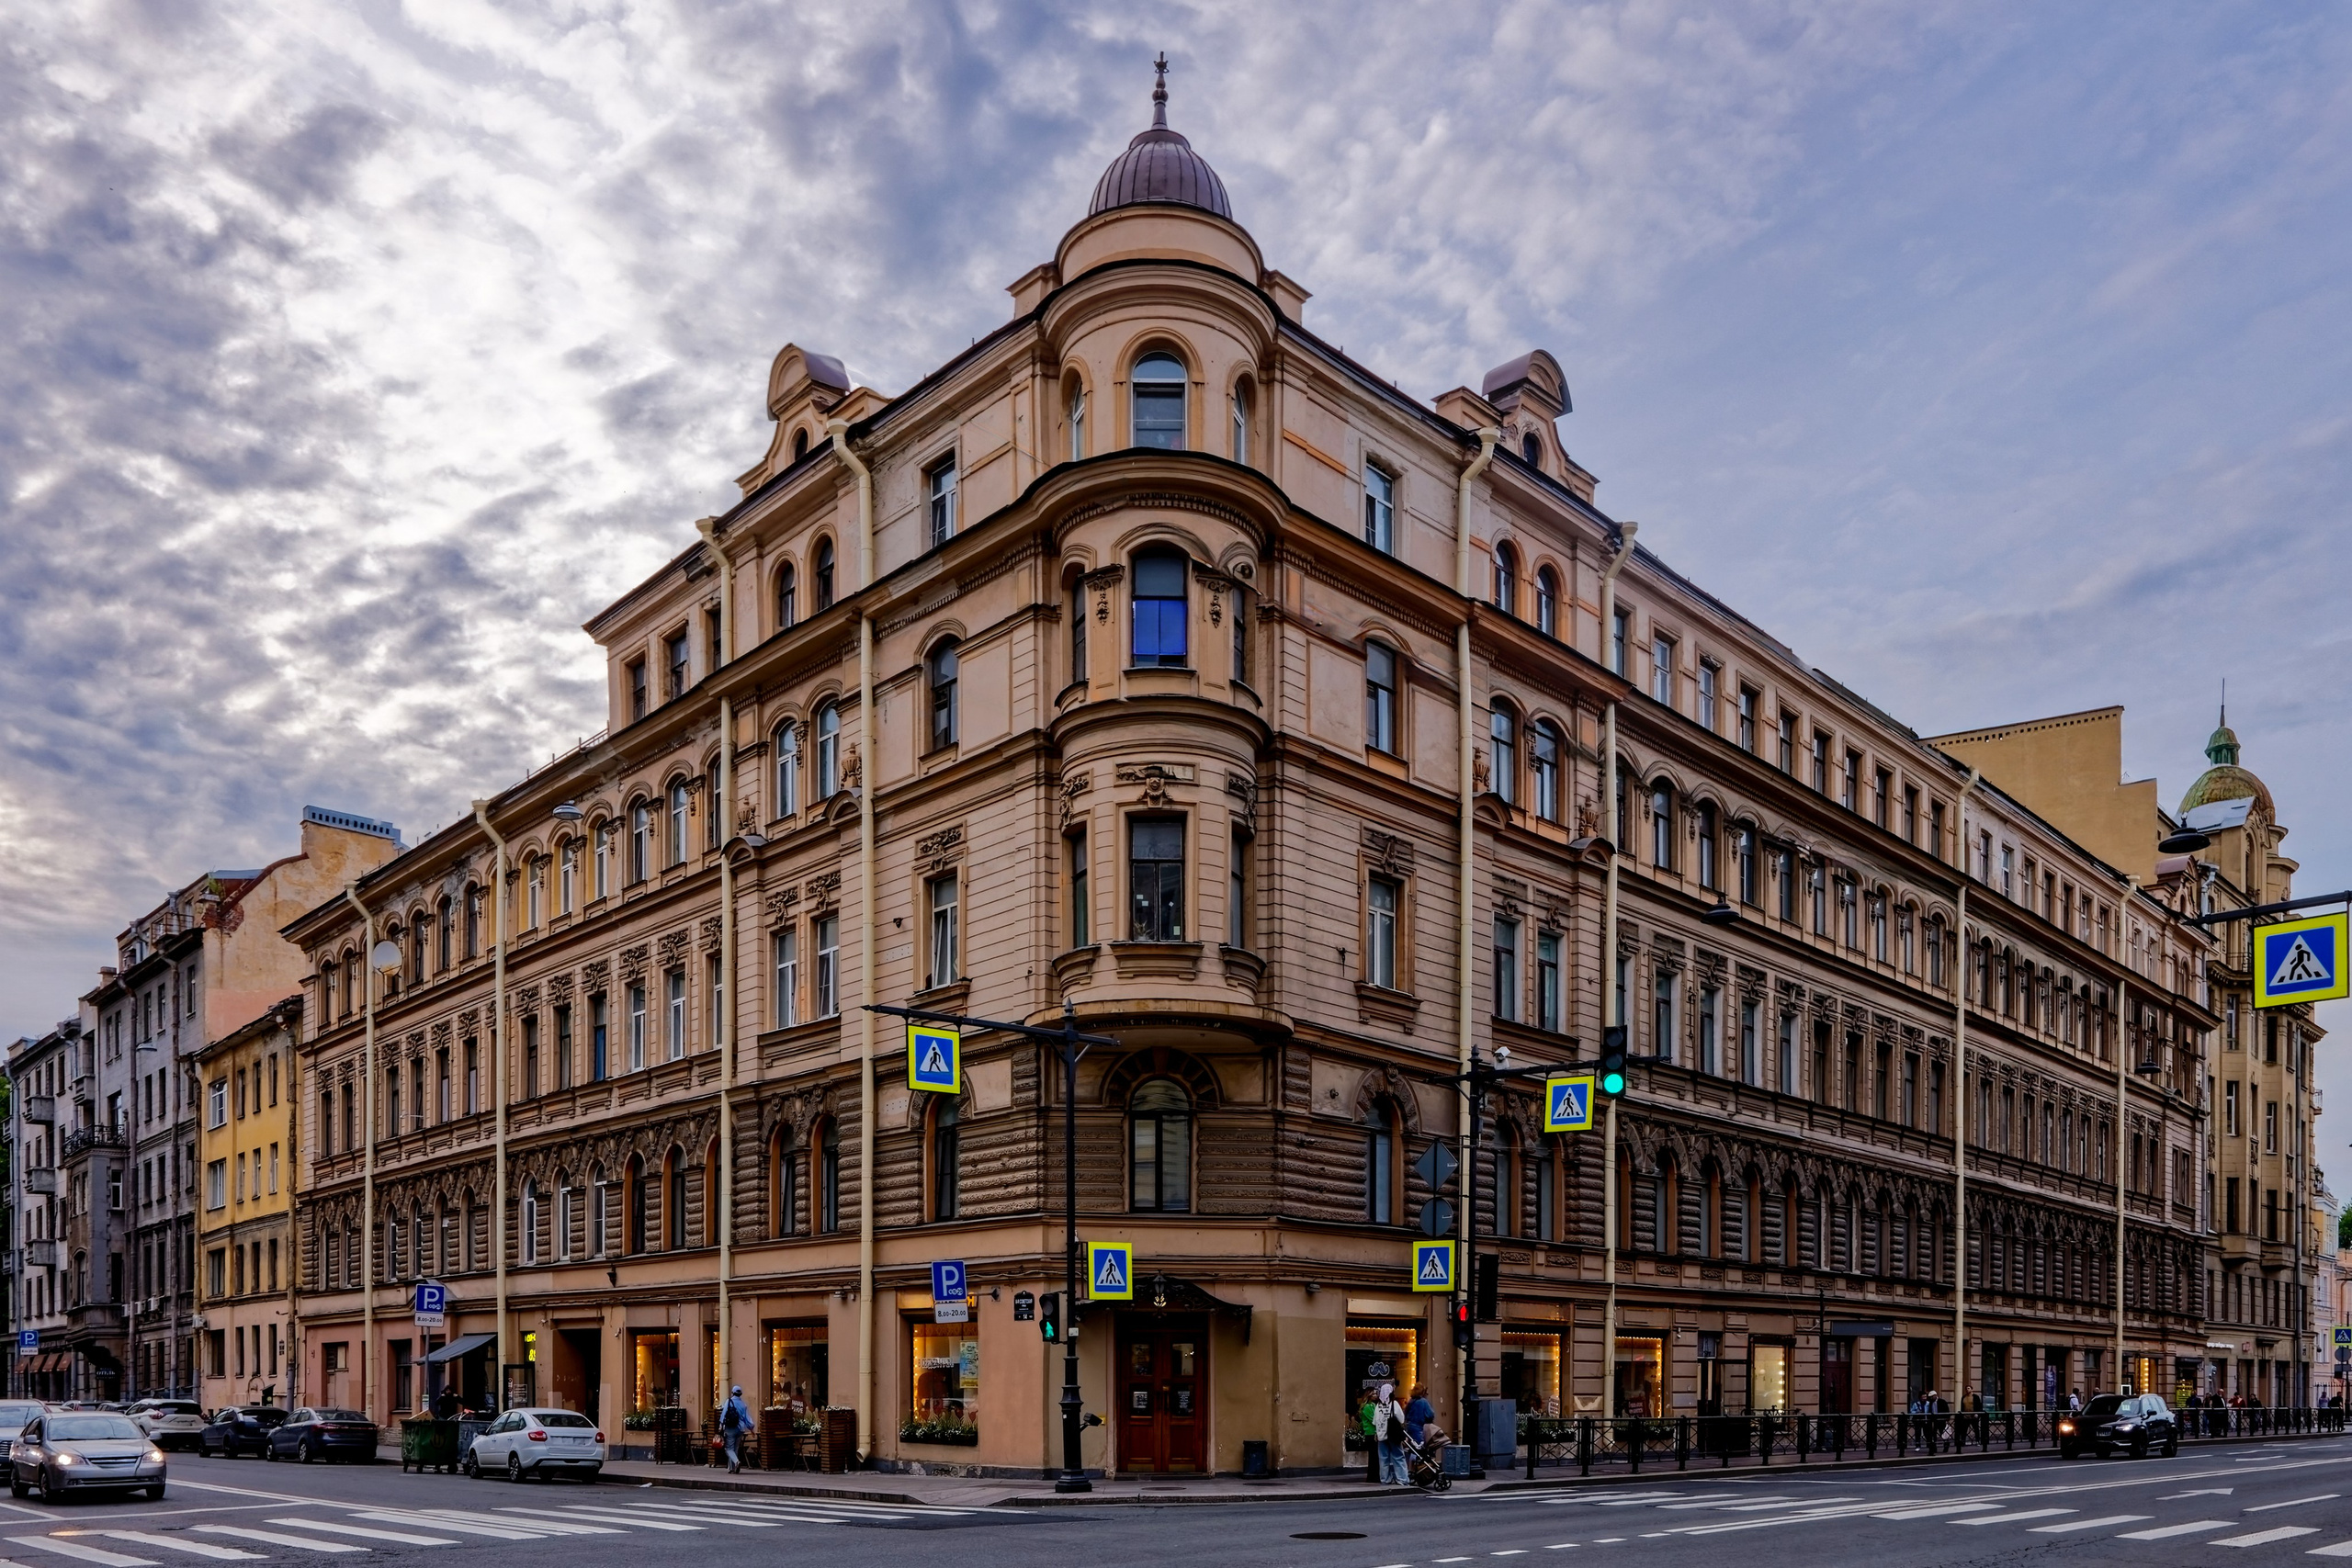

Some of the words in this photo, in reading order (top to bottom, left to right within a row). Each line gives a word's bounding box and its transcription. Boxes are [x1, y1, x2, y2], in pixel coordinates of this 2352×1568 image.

[942, 1265, 959, 1296] P
[424, 1288, 439, 1309] P
[937, 1309, 967, 1318] 8.00-20.00
[25, 1332, 35, 1345] P
